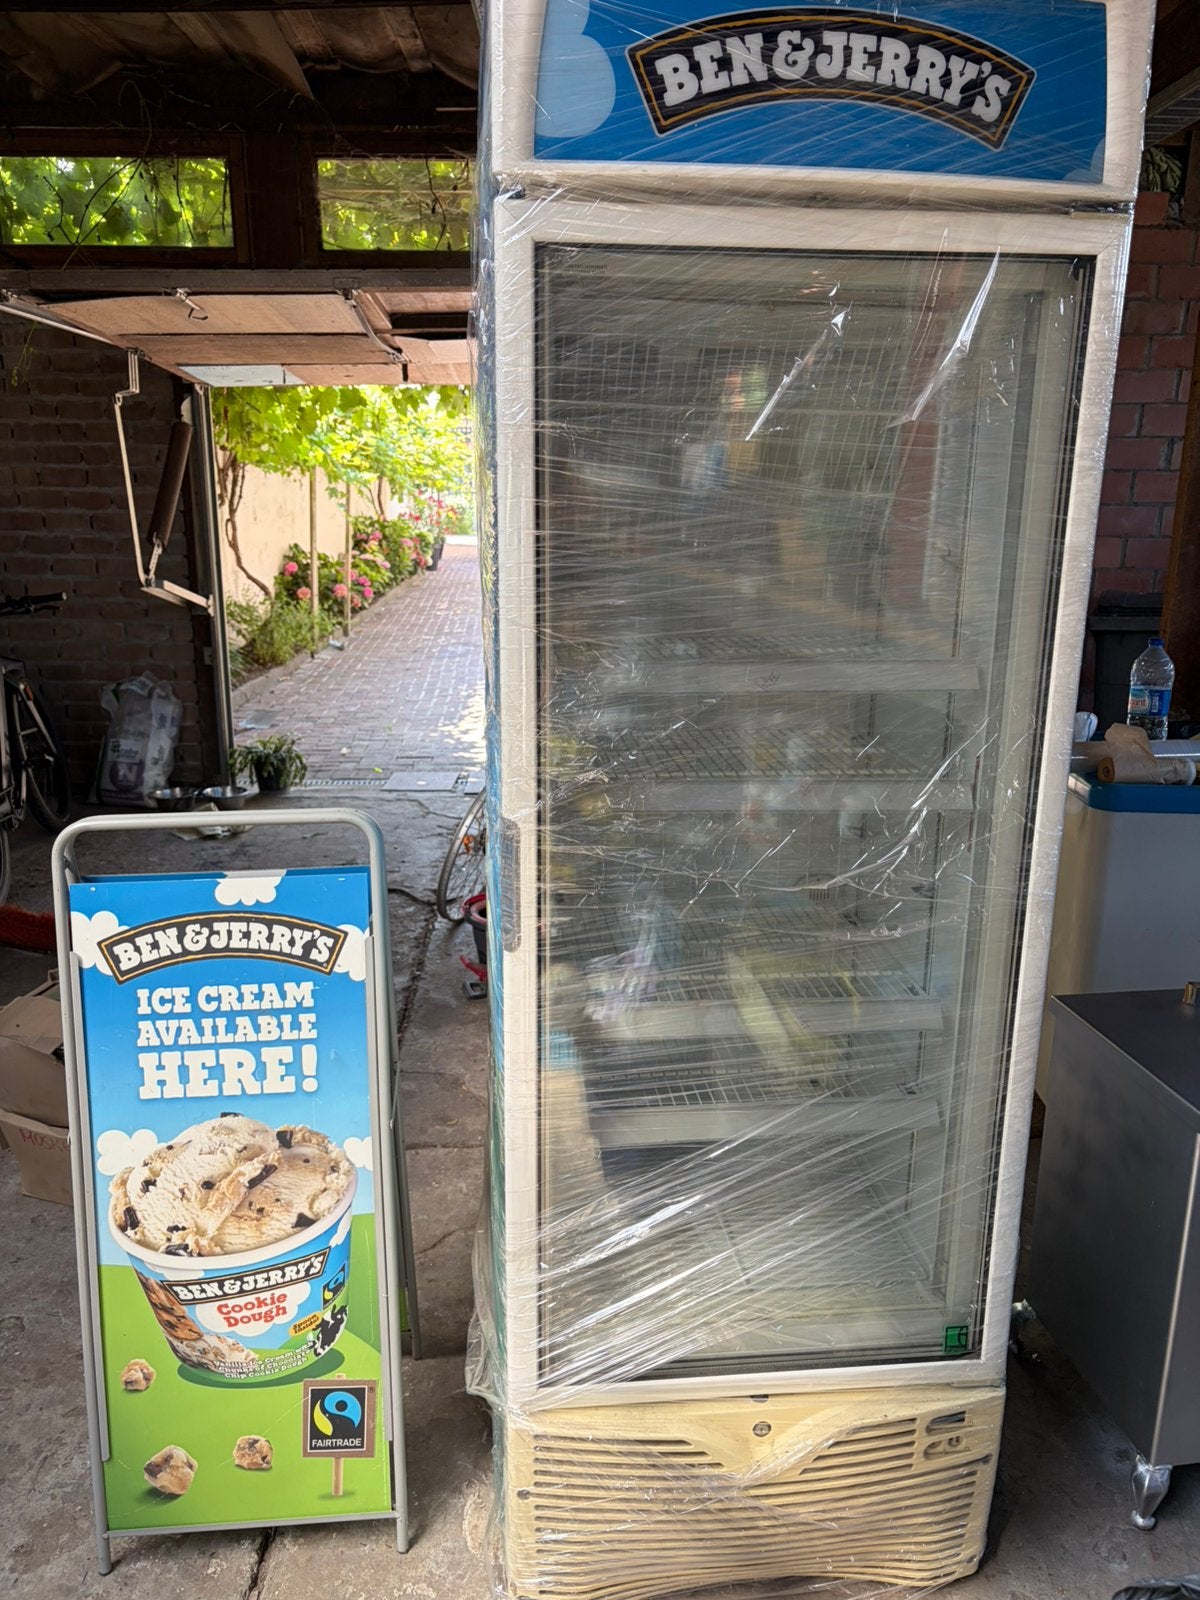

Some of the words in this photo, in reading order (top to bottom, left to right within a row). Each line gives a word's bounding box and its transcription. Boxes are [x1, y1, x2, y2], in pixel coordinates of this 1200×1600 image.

[137, 987, 192, 1015] ICE
[197, 981, 315, 1012] CREAM
[137, 1013, 318, 1047] AVAILABLE
[138, 1044, 318, 1100] HERE!
[216, 1292, 288, 1316] Cookie
[223, 1304, 287, 1328] Dough
[311, 1438, 362, 1448] FAIRTRADE
